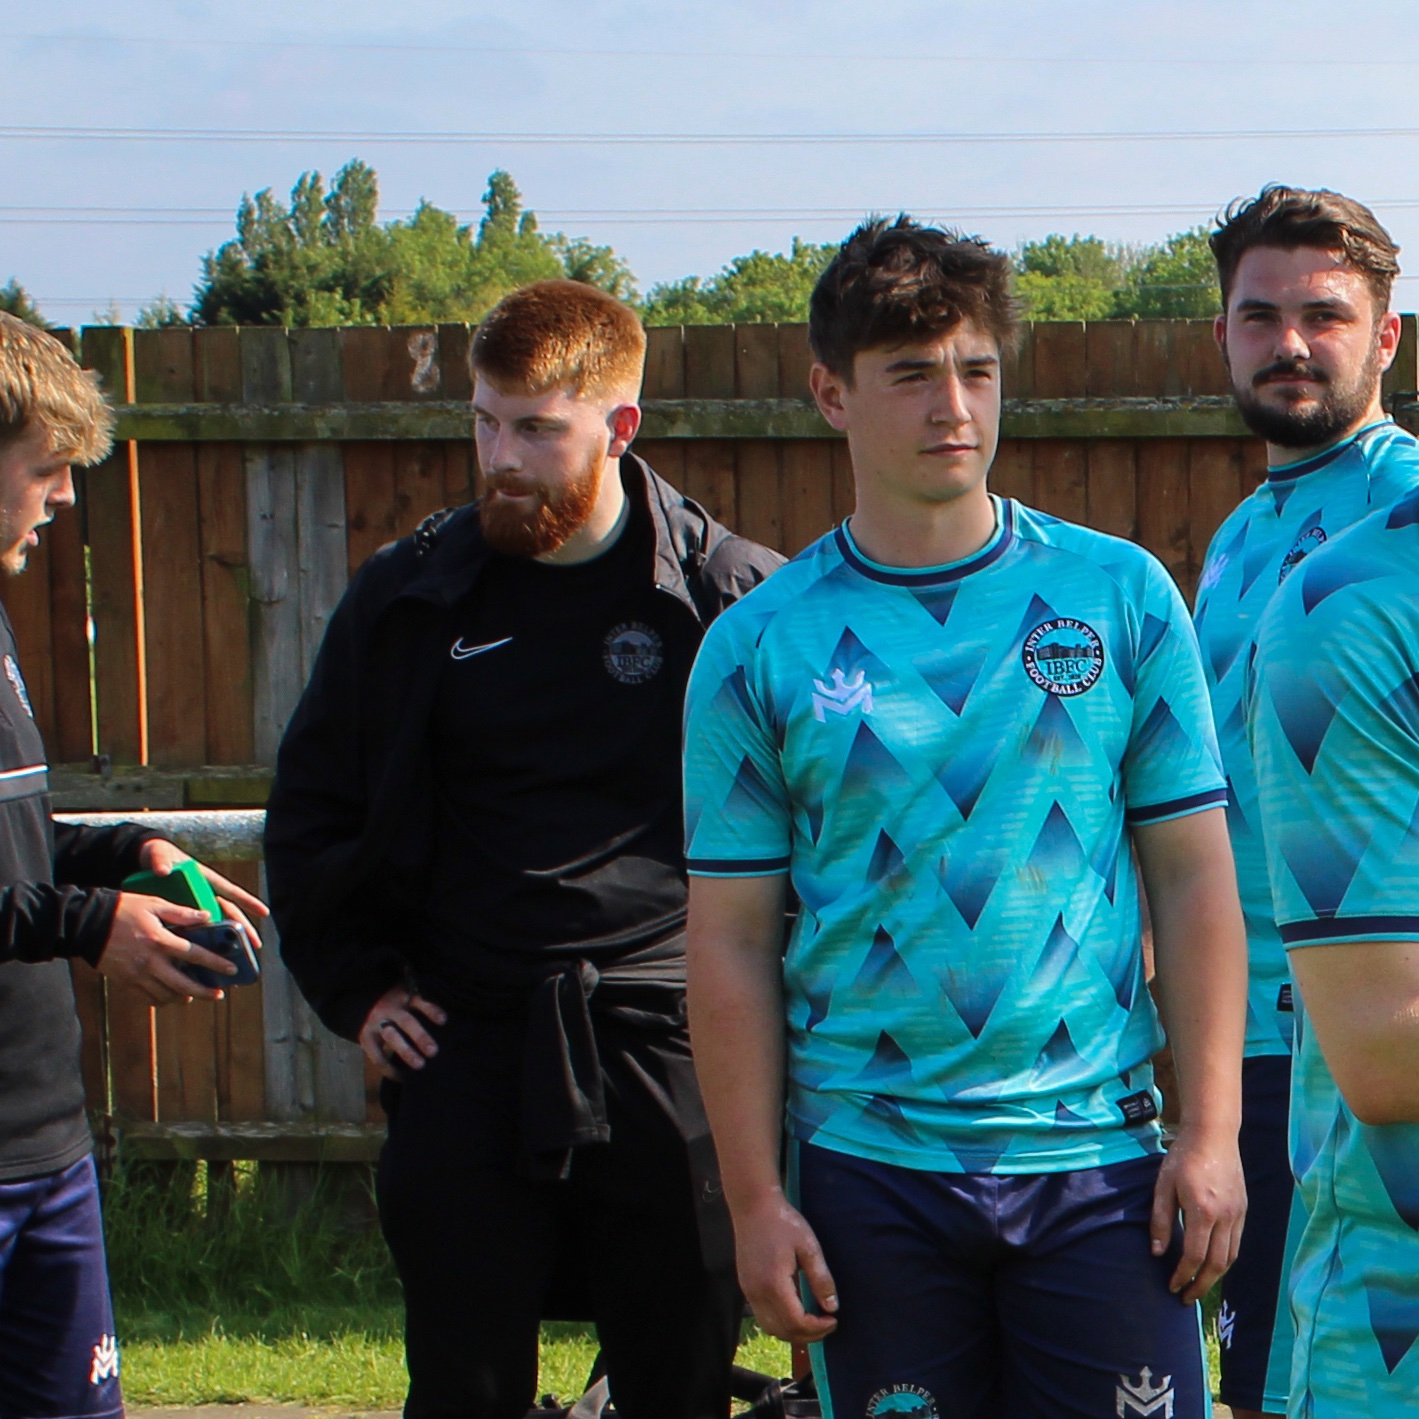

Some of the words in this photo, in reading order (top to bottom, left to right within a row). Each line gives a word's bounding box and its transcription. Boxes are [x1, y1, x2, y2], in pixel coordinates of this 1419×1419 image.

[1025, 622, 1053, 652] INTER
[1057, 619, 1099, 649] BELPER
[1025, 661, 1082, 694] FOOTBALL
[1082, 657, 1102, 687] CLUB
[1046, 659, 1087, 675] IBFC
